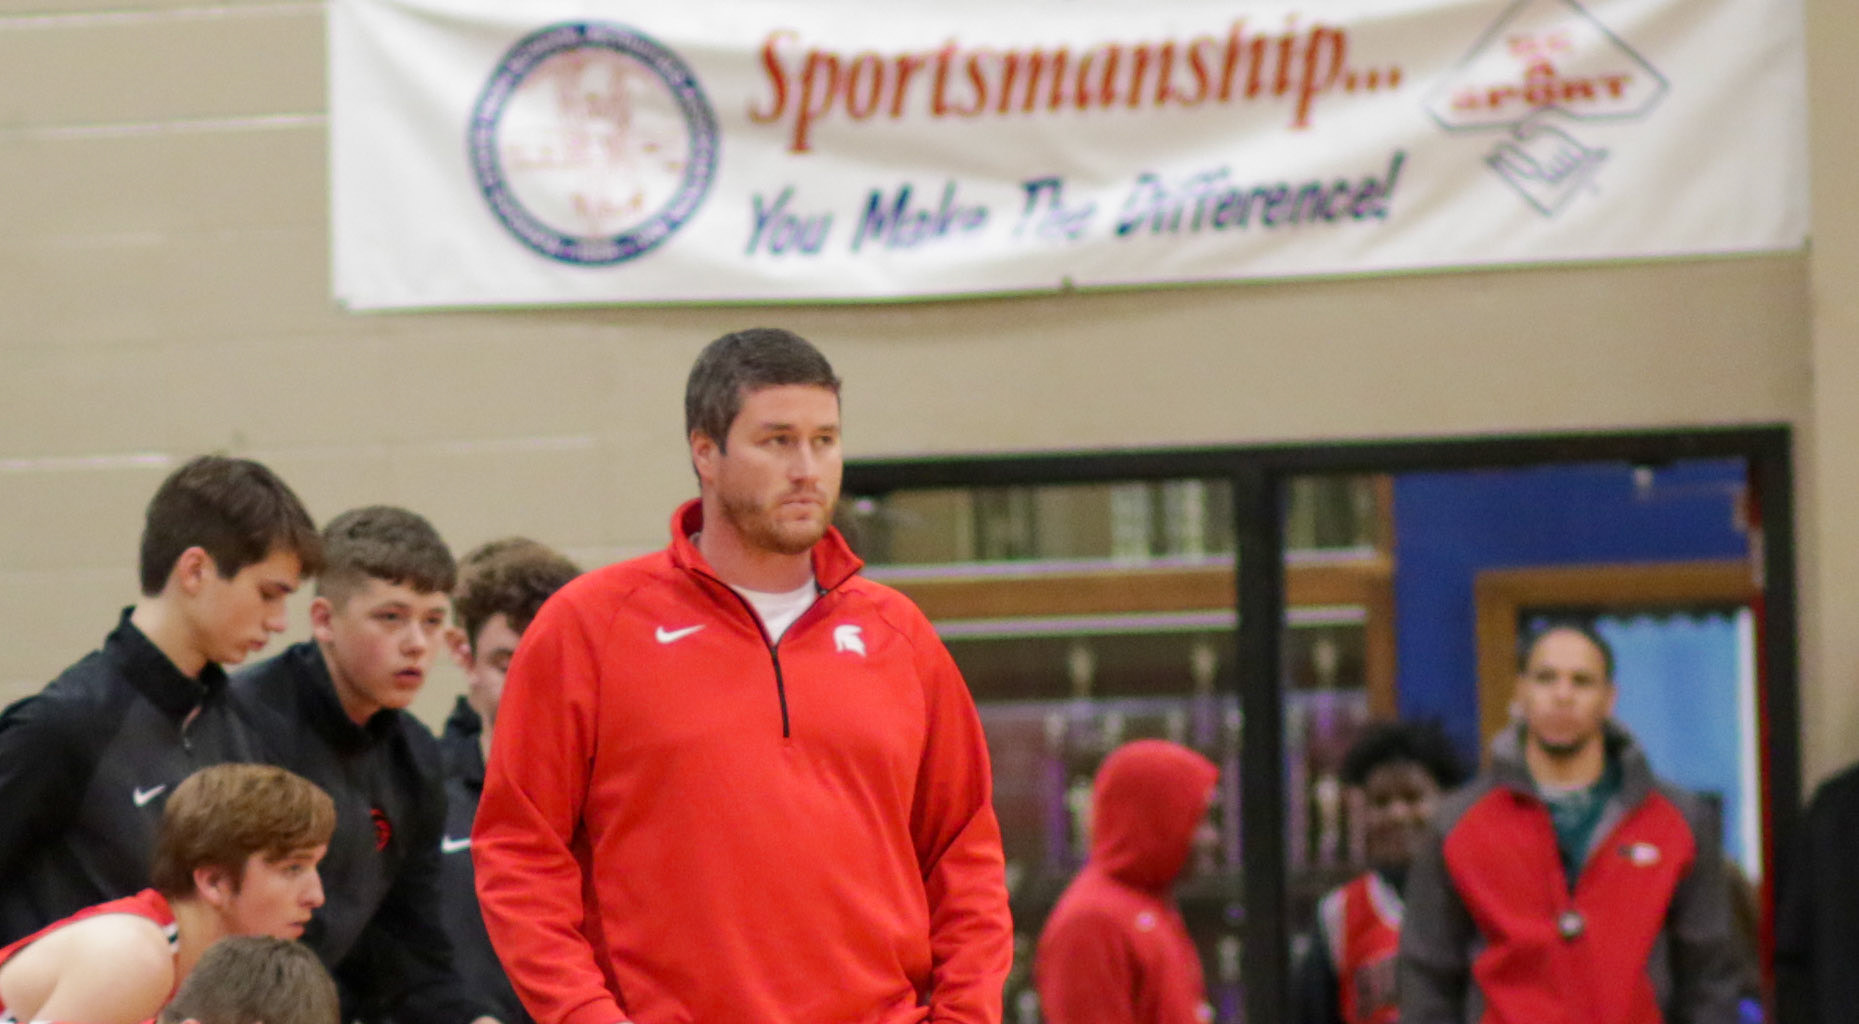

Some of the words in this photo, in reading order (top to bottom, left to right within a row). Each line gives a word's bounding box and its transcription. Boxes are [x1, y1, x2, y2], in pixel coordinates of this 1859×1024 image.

[747, 18, 1403, 153] Sportsmanship...
[746, 183, 833, 254] You
[850, 180, 988, 253] Make
